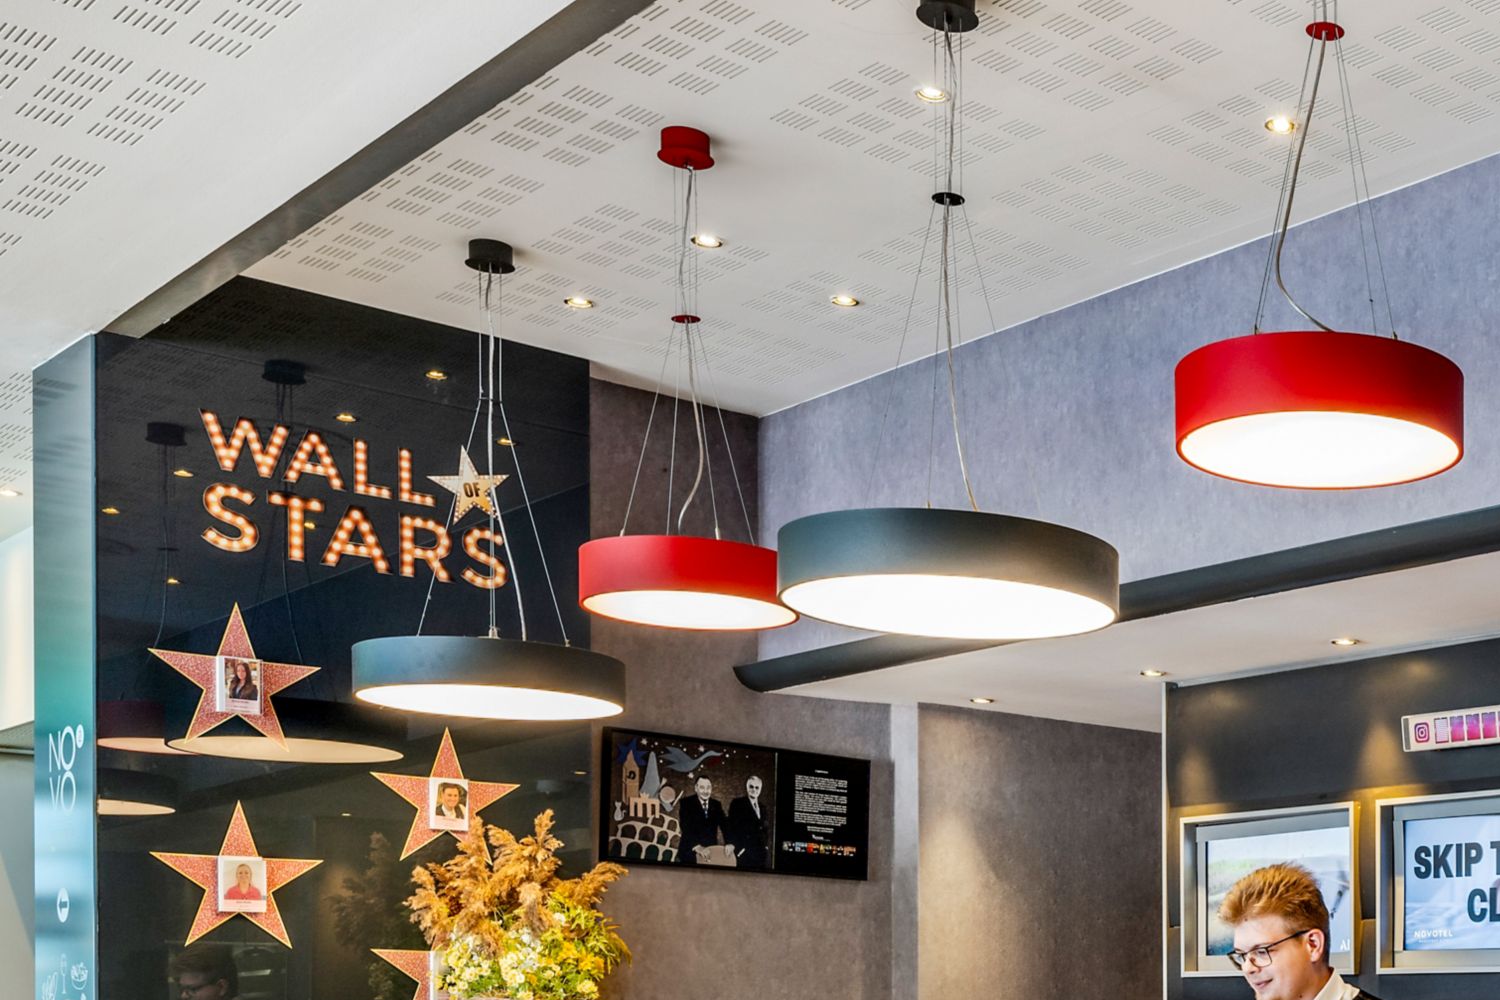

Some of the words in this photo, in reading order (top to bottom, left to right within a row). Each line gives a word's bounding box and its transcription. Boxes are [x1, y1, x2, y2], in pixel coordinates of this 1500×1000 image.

[199, 408, 436, 507] WALL
[463, 482, 482, 498] OF
[201, 482, 507, 588] STARS
[1414, 842, 1483, 880] SKIP
[1414, 929, 1453, 938] NOVOTEL
